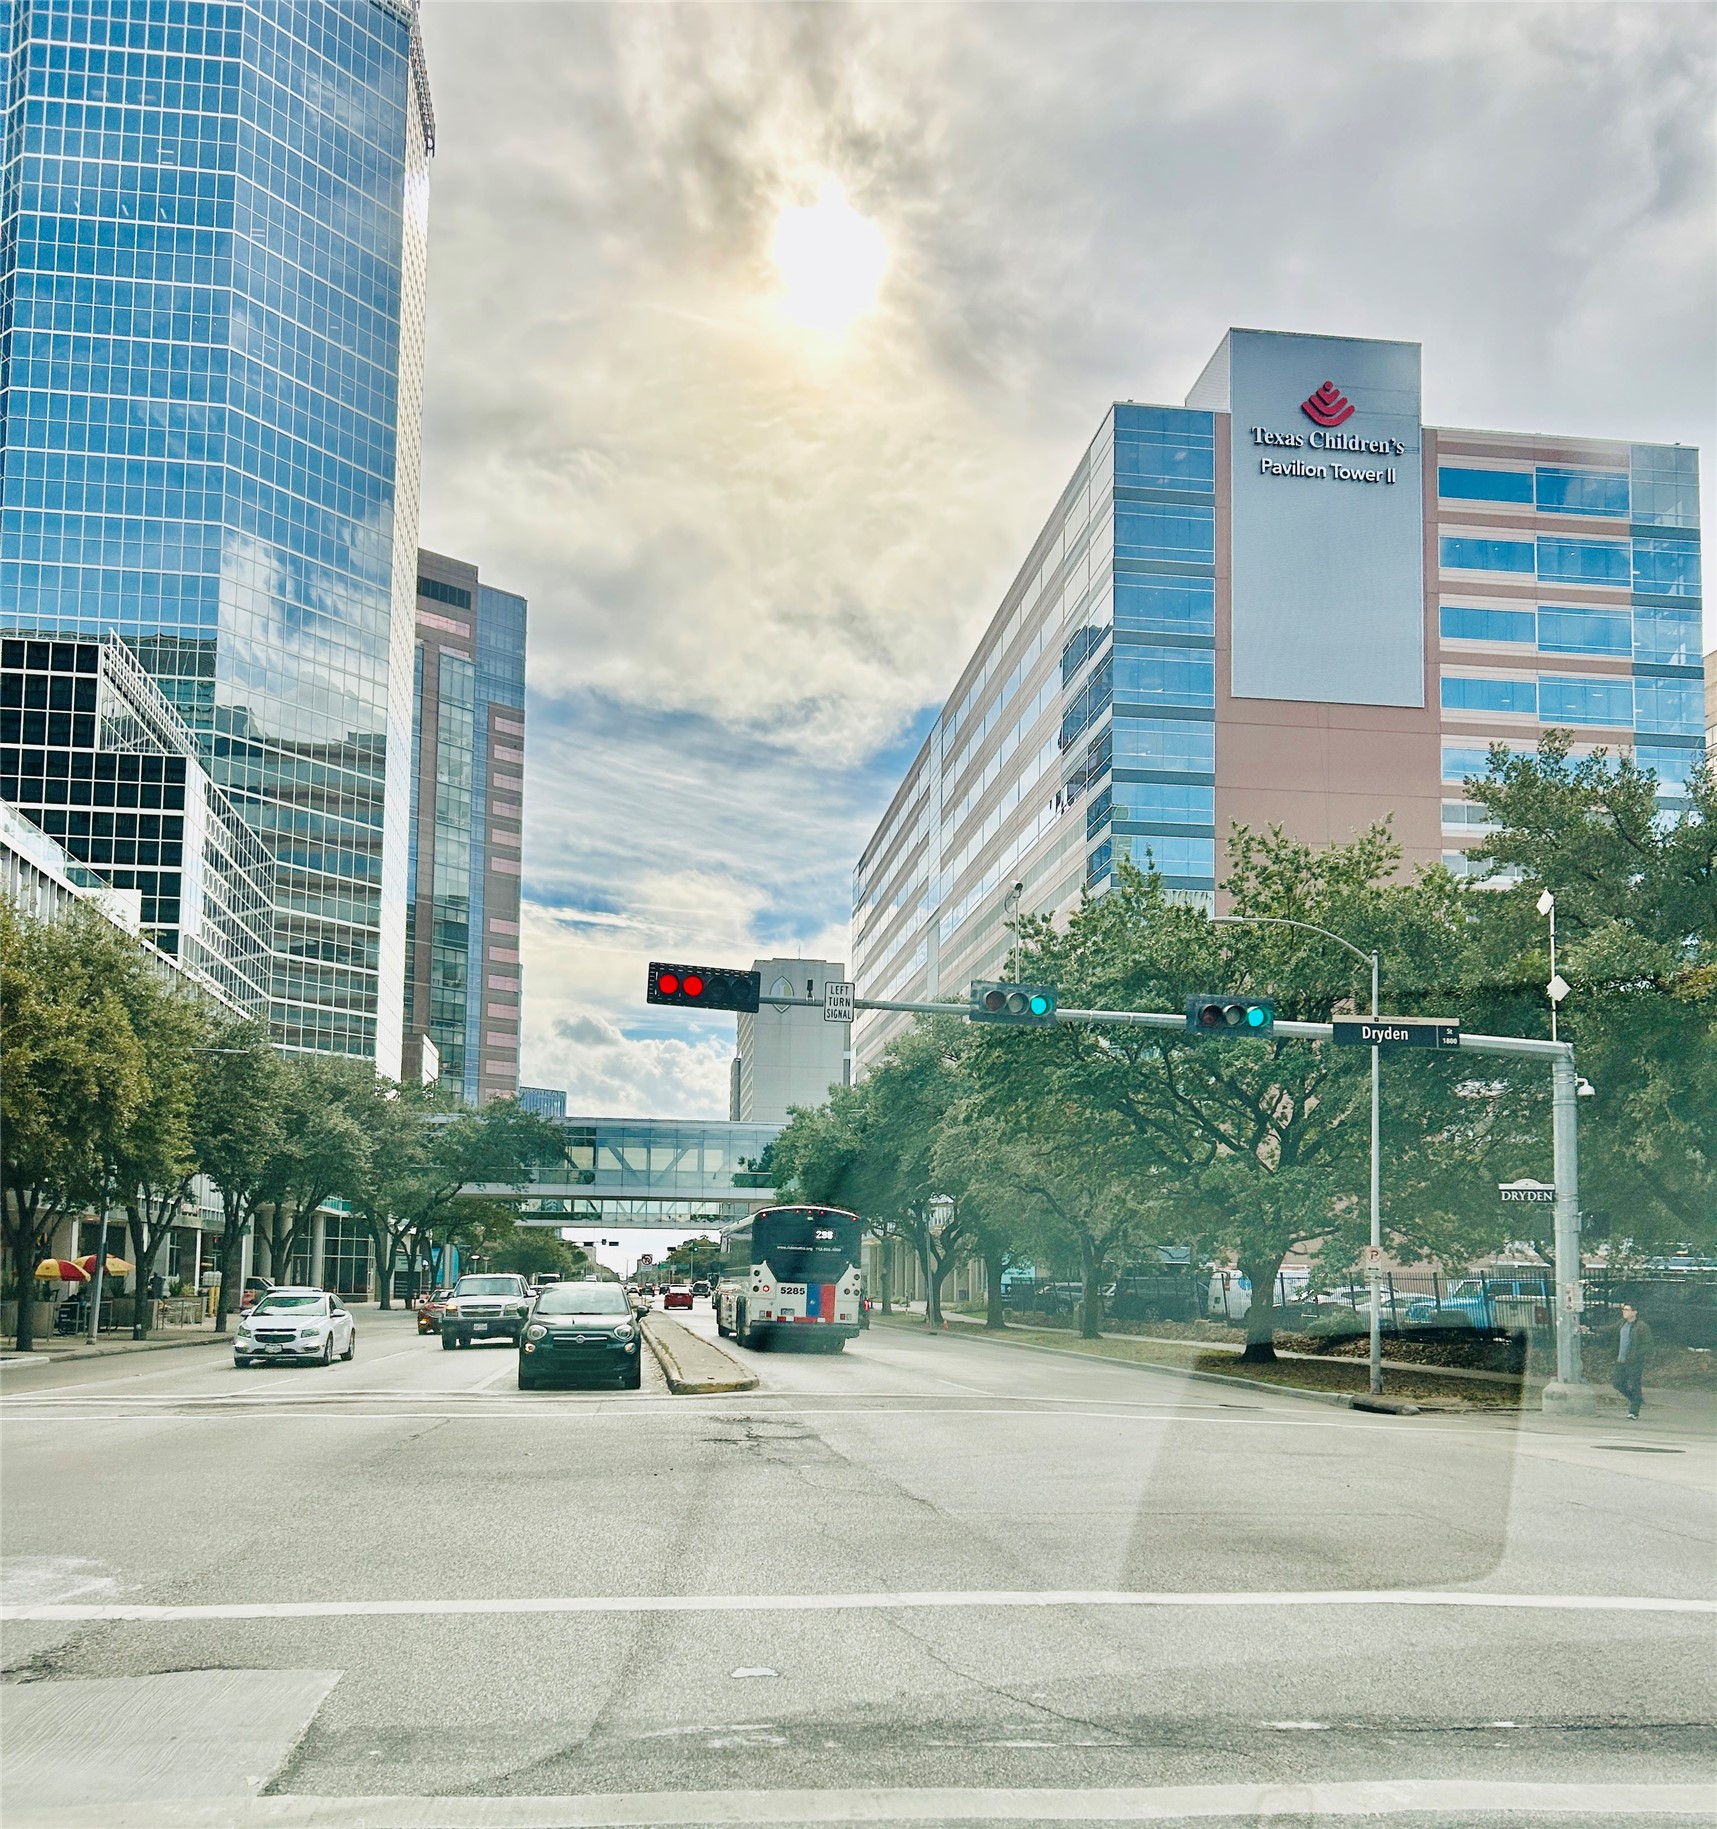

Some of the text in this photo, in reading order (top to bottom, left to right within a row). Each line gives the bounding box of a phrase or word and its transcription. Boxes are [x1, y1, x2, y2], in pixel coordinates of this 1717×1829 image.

[1252, 426, 1405, 454] Texas Children's
[1261, 457, 1327, 478] Pavilion
[1330, 463, 1383, 482] Tower
[830, 985, 849, 996] LEFT
[828, 996, 851, 1007] TURN
[826, 1008, 852, 1020] SIGNAL
[1362, 1026, 1409, 1043] Dryden
[1501, 1190, 1553, 1201] DRYDEN
[780, 1286, 806, 1296] 5285
